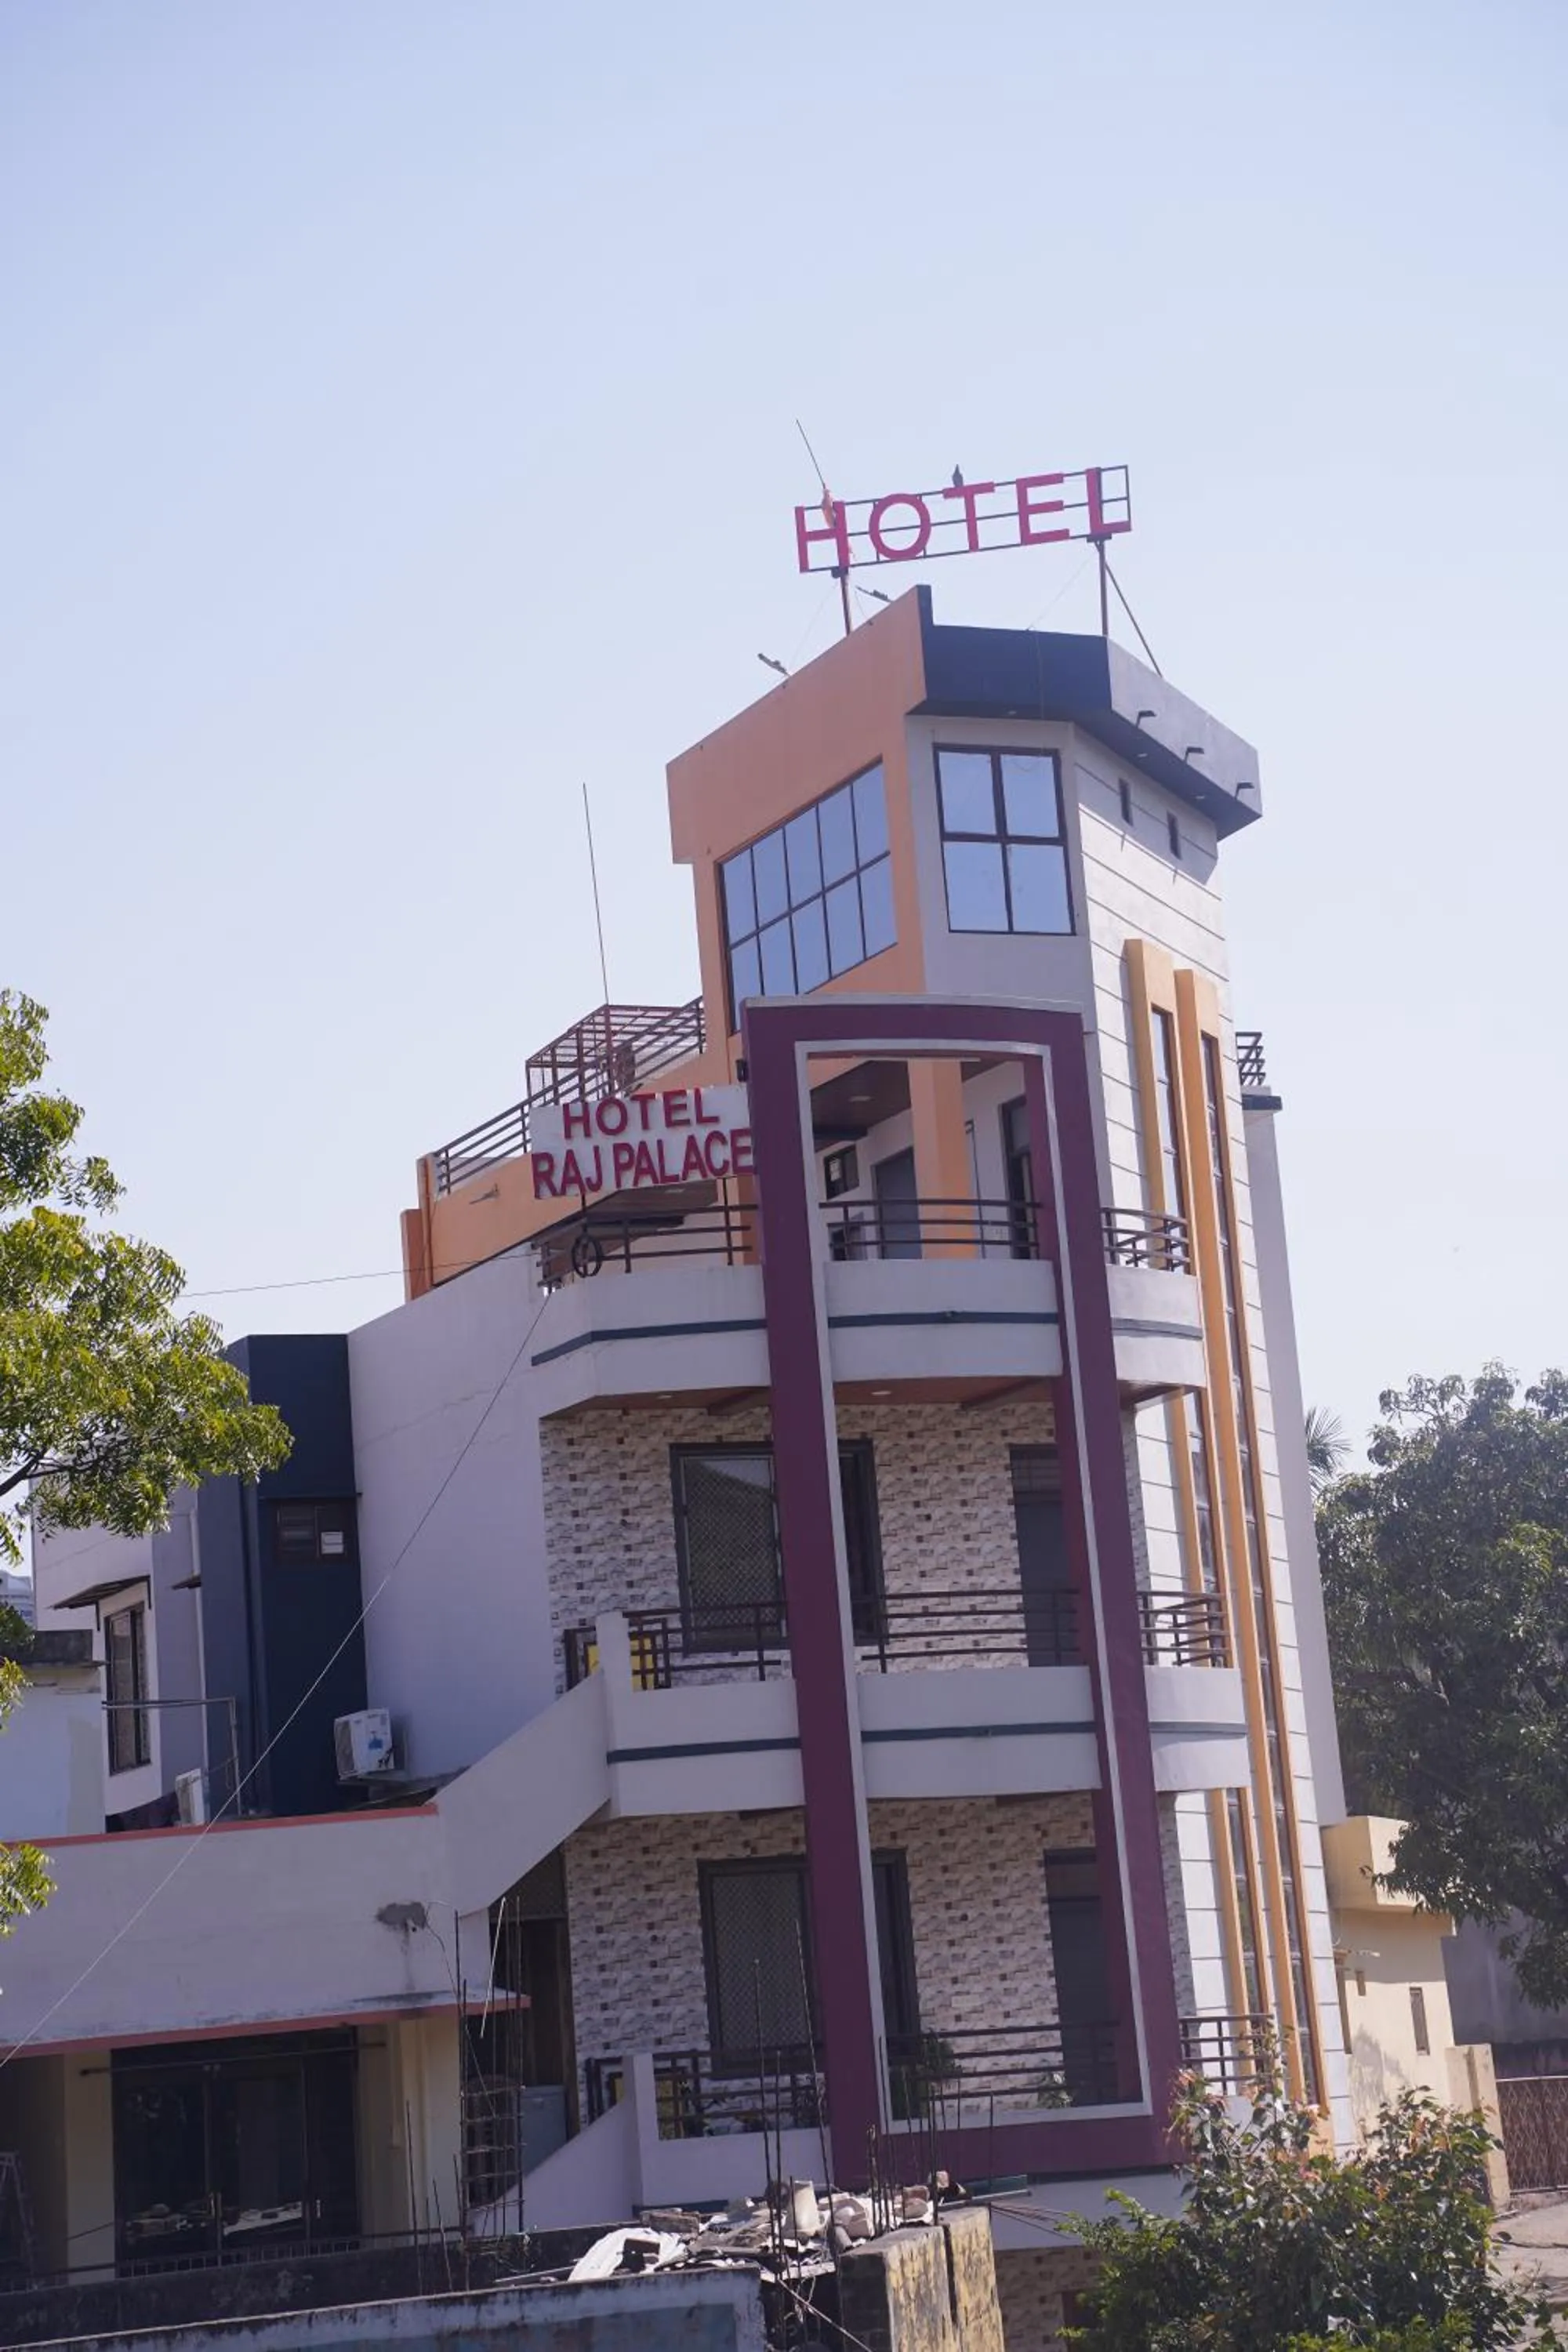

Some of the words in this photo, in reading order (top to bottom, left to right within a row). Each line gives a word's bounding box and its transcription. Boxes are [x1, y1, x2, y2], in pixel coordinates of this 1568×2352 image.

[794, 466, 1131, 573] HOTEL
[562, 1087, 720, 1140] HOTEL
[532, 1145, 604, 1200] RAJ
[612, 1127, 754, 1189] PALACE
